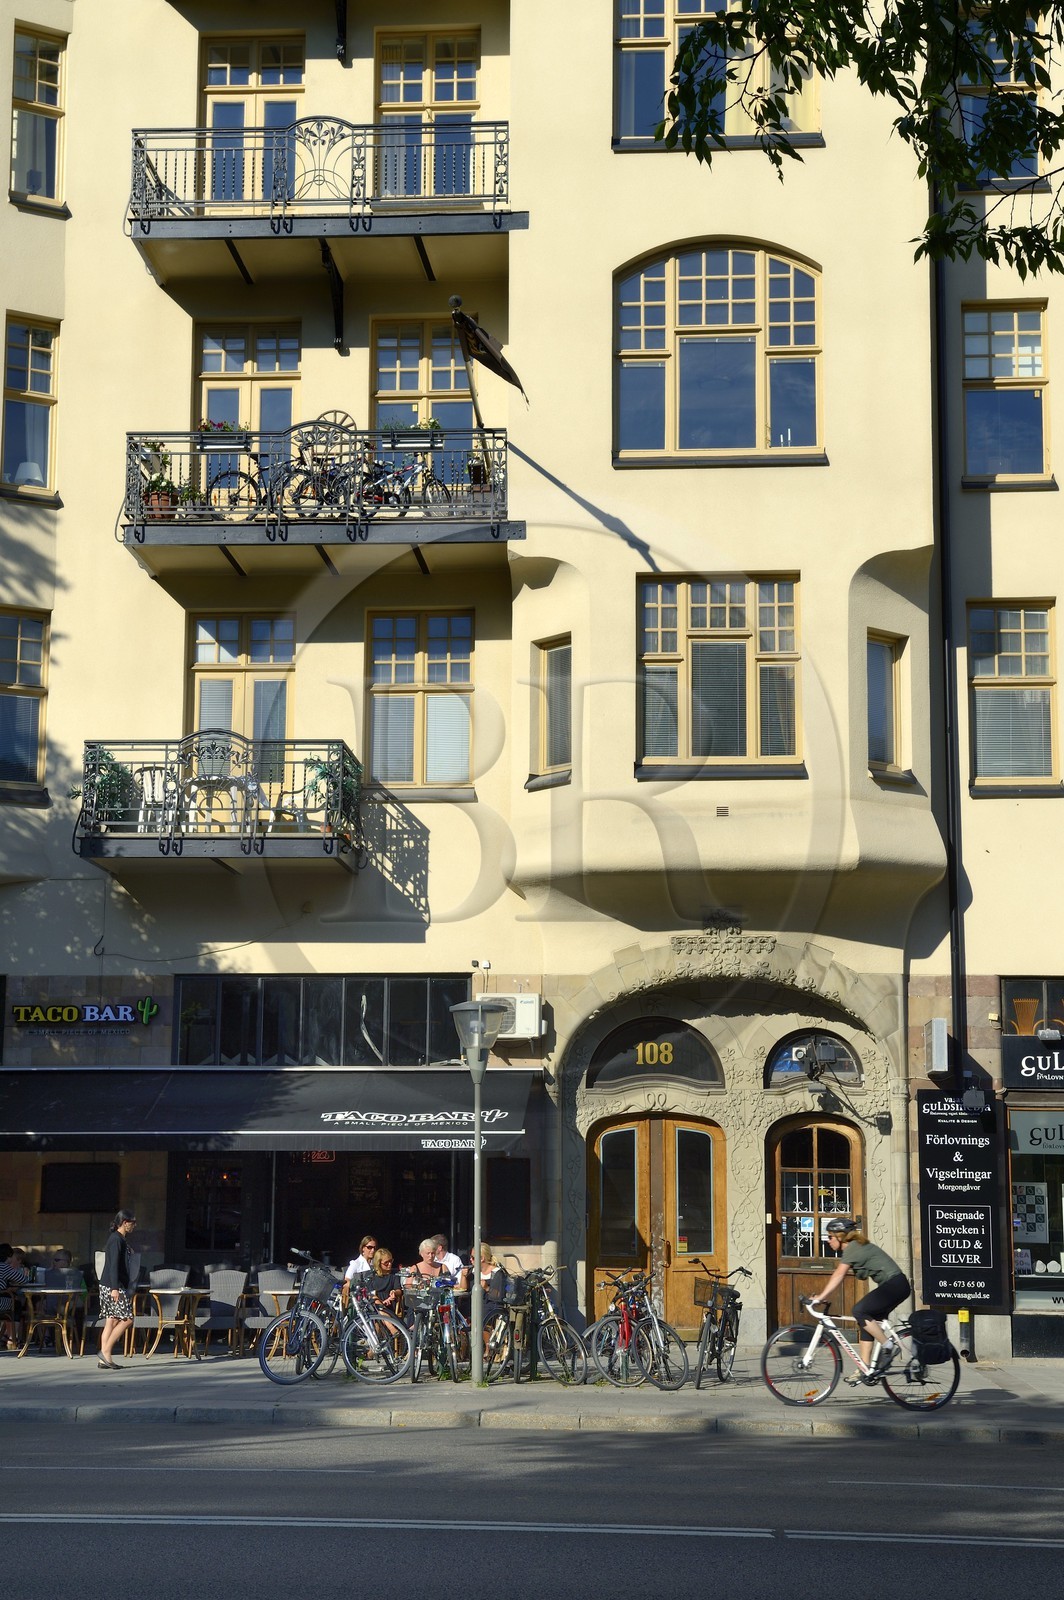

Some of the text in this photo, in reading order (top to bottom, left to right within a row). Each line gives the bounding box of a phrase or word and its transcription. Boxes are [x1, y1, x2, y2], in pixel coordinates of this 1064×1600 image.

[13, 1005, 135, 1022] TACO BAR
[635, 1042, 674, 1065] 108
[321, 1110, 476, 1122] TACO BAR
[421, 1139, 476, 1149] TACO BAR
[926, 1134, 990, 1148] Förlovnings
[952, 1151, 964, 1162] &
[926, 1167, 992, 1182] Vigselringar
[938, 1183, 981, 1192] Morgongåvor
[935, 1209, 985, 1222] Designade
[935, 1224, 985, 1236] Smycken i
[938, 1239, 983, 1250] GULD &
[941, 1253, 981, 1264] SILVER
[938, 1280, 948, 1288] 08
[953, 1280, 965, 1288] 673
[934, 1292, 990, 1300] www.vasaguld.se
